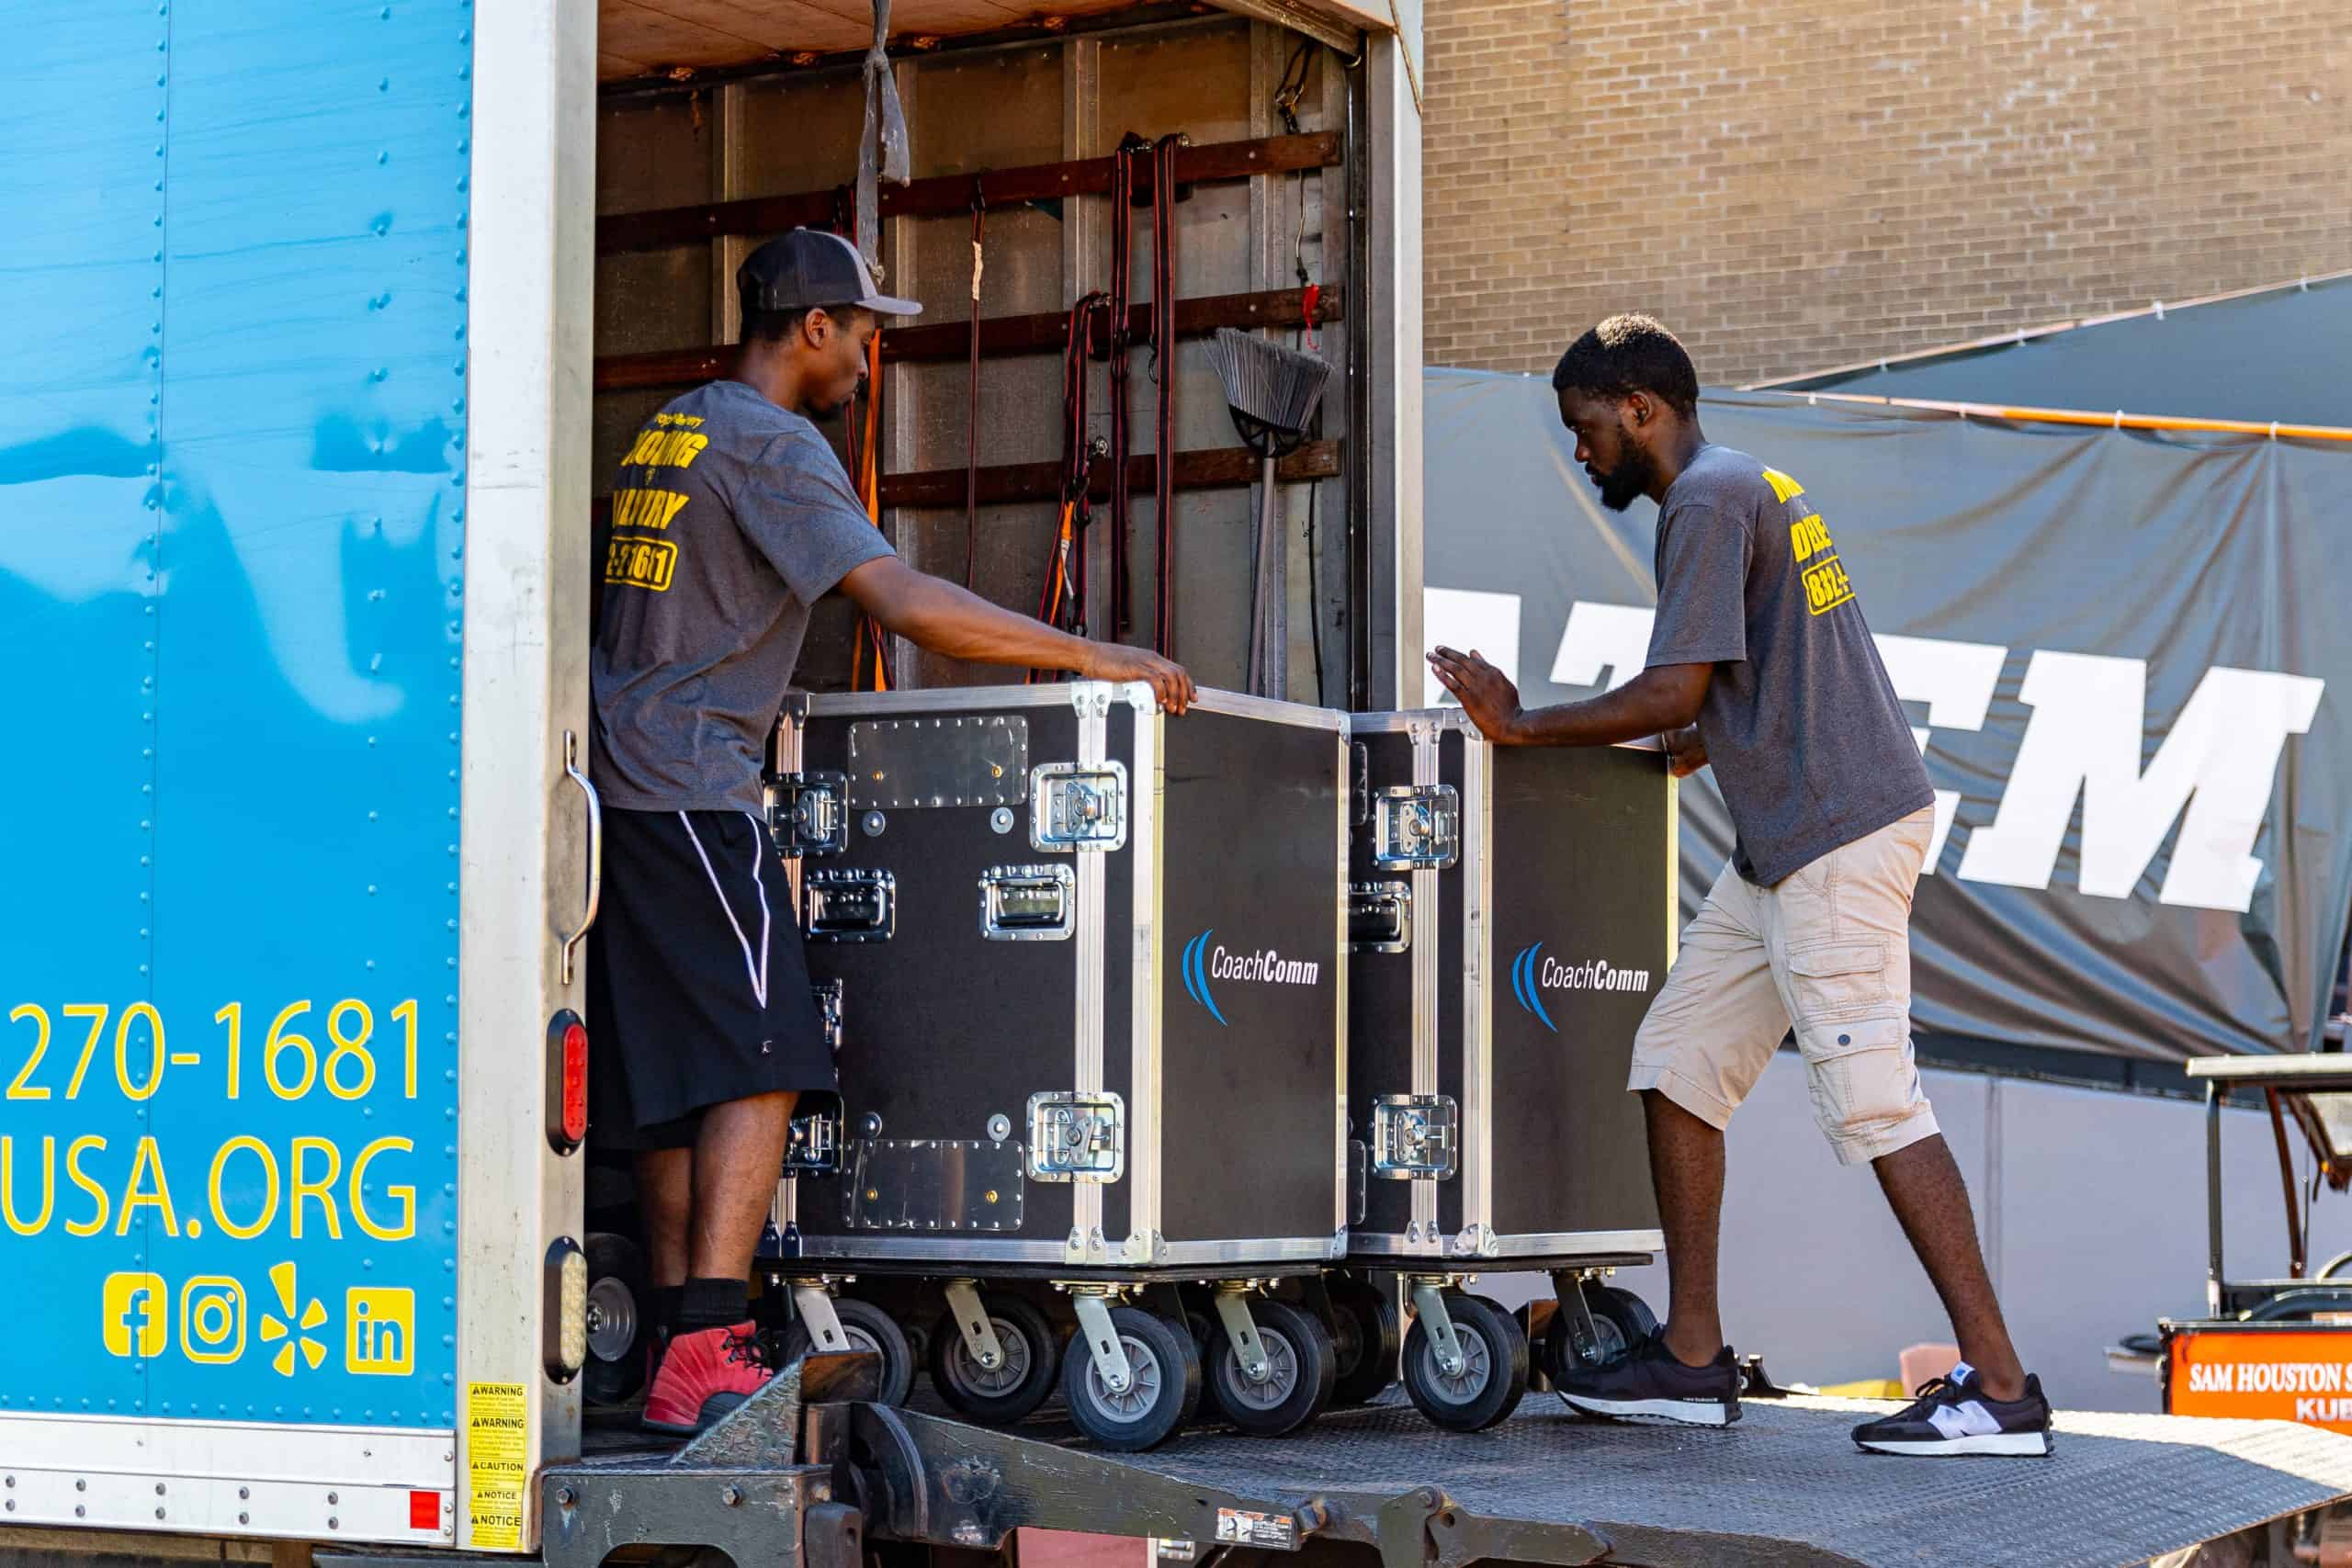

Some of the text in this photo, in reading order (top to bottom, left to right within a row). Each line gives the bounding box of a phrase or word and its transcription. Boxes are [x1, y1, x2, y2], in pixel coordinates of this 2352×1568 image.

[1211, 946, 1319, 986] CoachComm
[1541, 956, 1650, 993] CoachComm
[6, 998, 418, 1101] 270-1681
[0, 1135, 417, 1241] USA.ORG
[2189, 1363, 2233, 1392] SAM
[2236, 1363, 2342, 1393] HOUSTON
[481, 1386, 524, 1396] WARNING
[481, 1417, 524, 1428] WARNING
[481, 1461, 524, 1471] CAUTION
[484, 1491, 517, 1500] NOTICE
[481, 1515, 522, 1527] NOTICE
